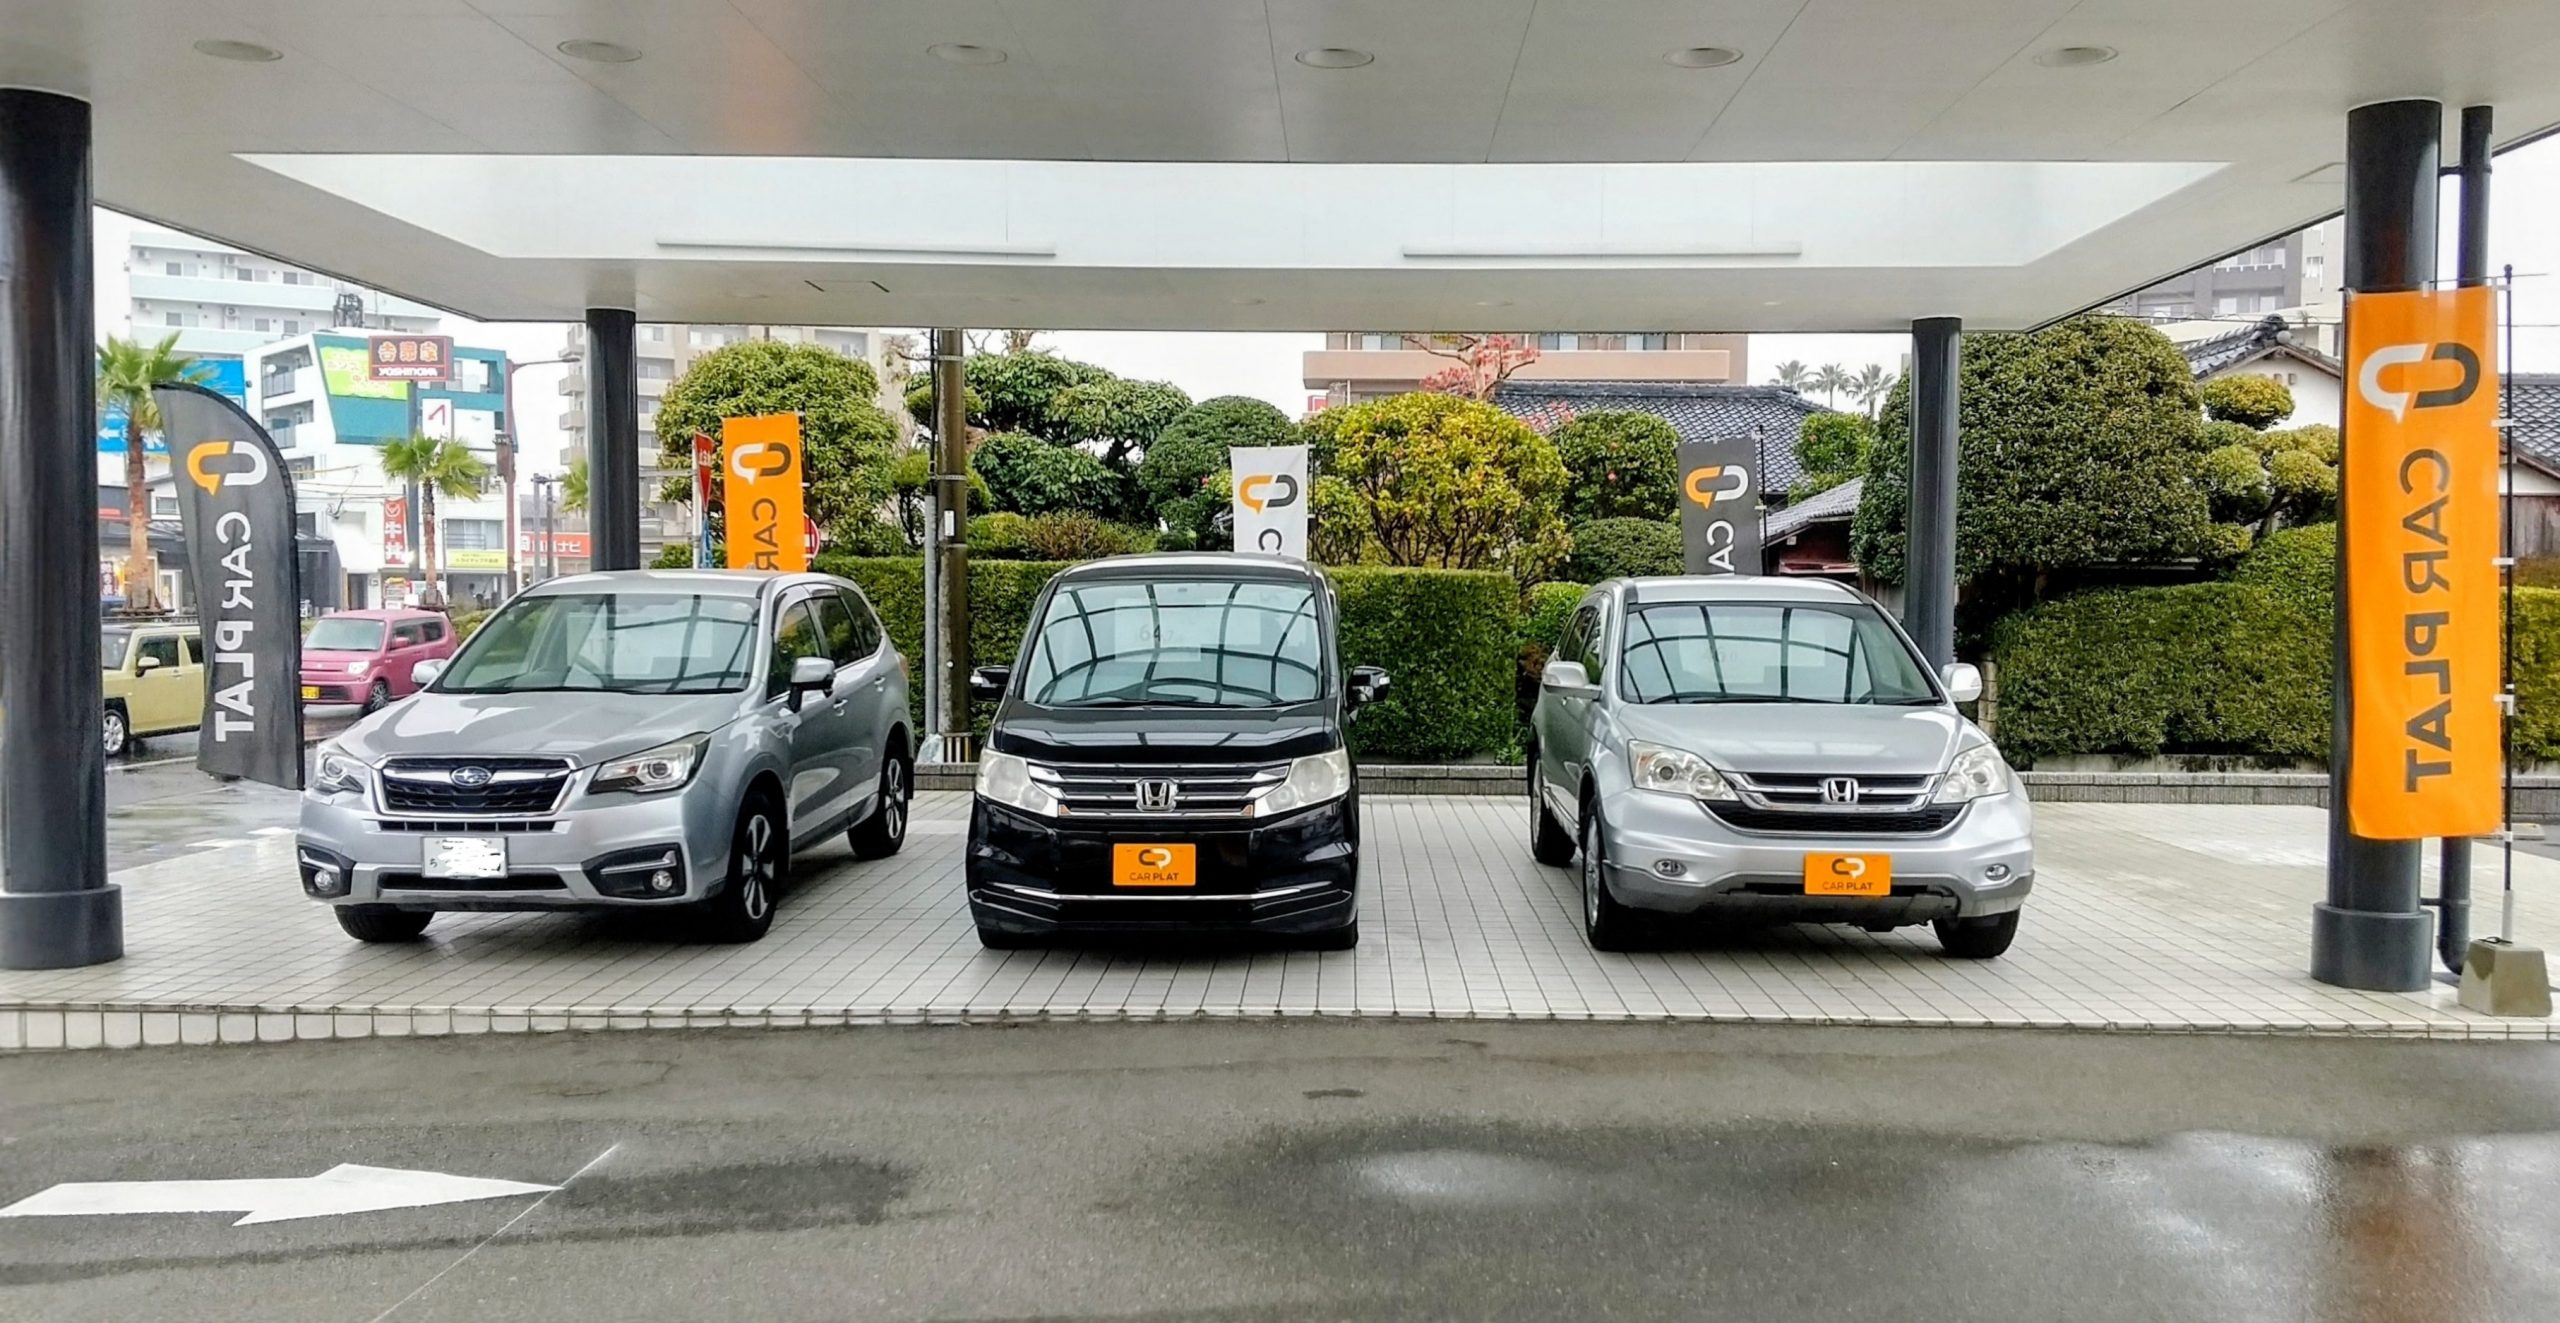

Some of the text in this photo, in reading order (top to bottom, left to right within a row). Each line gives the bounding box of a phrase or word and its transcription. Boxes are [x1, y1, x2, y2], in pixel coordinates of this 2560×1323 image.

[378, 341, 438, 362] 吉野家
[378, 367, 438, 376] YOSHINOYA
[1129, 872, 1179, 881] CAR PLAT
[1822, 881, 1873, 891] CAR PLAT
